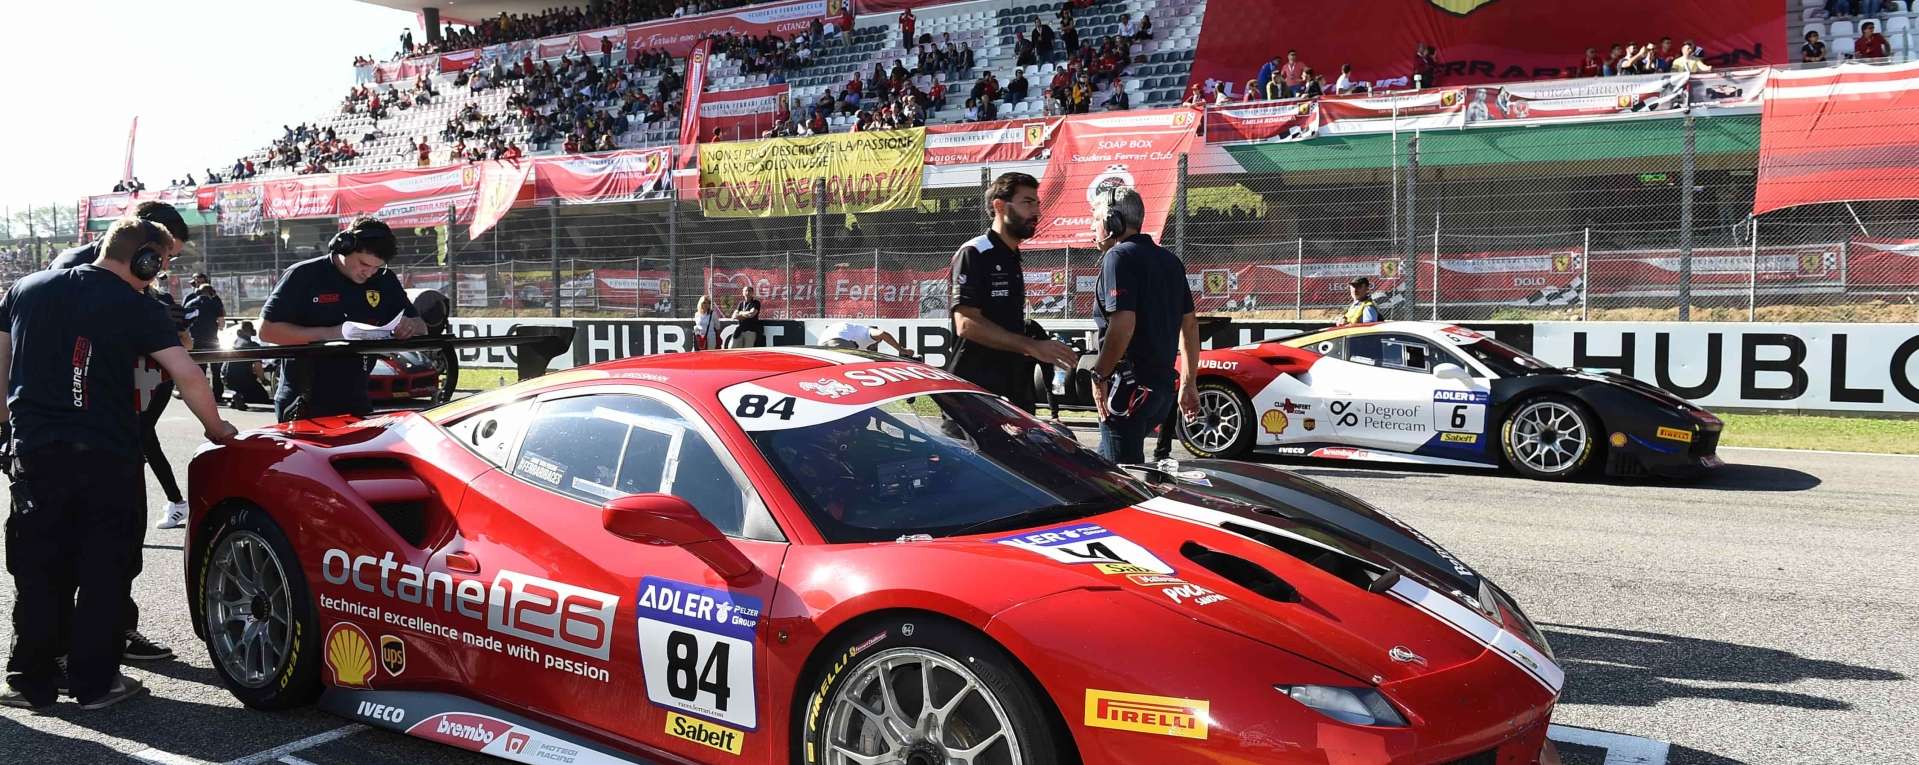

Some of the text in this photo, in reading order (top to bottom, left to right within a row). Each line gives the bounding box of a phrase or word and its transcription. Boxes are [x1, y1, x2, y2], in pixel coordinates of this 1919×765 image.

[776, 20, 811, 33] CATANZA
[1001, 130, 1022, 140] CLUB
[707, 149, 731, 161] NON
[839, 140, 853, 152] LA
[1097, 139, 1153, 150] SOAP BOX
[929, 153, 969, 163] BOLOGNA
[1071, 150, 1174, 163] Scuderia Ferrari Club
[707, 163, 720, 175] LA
[704, 180, 772, 212] FORZA
[1053, 216, 1092, 226] CHAM
[835, 279, 917, 302] Ferrari
[991, 289, 1009, 297] STATE
[1434, 390, 1469, 402] ADLER
[735, 393, 798, 421] 84
[1364, 402, 1421, 419] Degroof
[1364, 416, 1426, 433] Petercam
[1451, 404, 1468, 429] 6
[1660, 430, 1690, 440] PIRELLI
[1278, 447, 1305, 455] IVECO
[639, 584, 714, 621] ADLER
[733, 605, 759, 617] PELZER
[731, 615, 757, 628] GROUP
[320, 593, 611, 683] technical excellence made with passion
[382, 647, 404, 670] ups
[666, 629, 731, 713] 84
[809, 653, 849, 732] PIRELLI
[356, 700, 406, 724] IVECO
[1097, 697, 1196, 730] PIRELLI
[436, 715, 495, 745] brembo
[672, 715, 736, 752] Sabelt
[536, 750, 576, 765] RACING
[541, 743, 579, 757] MOTEGI
